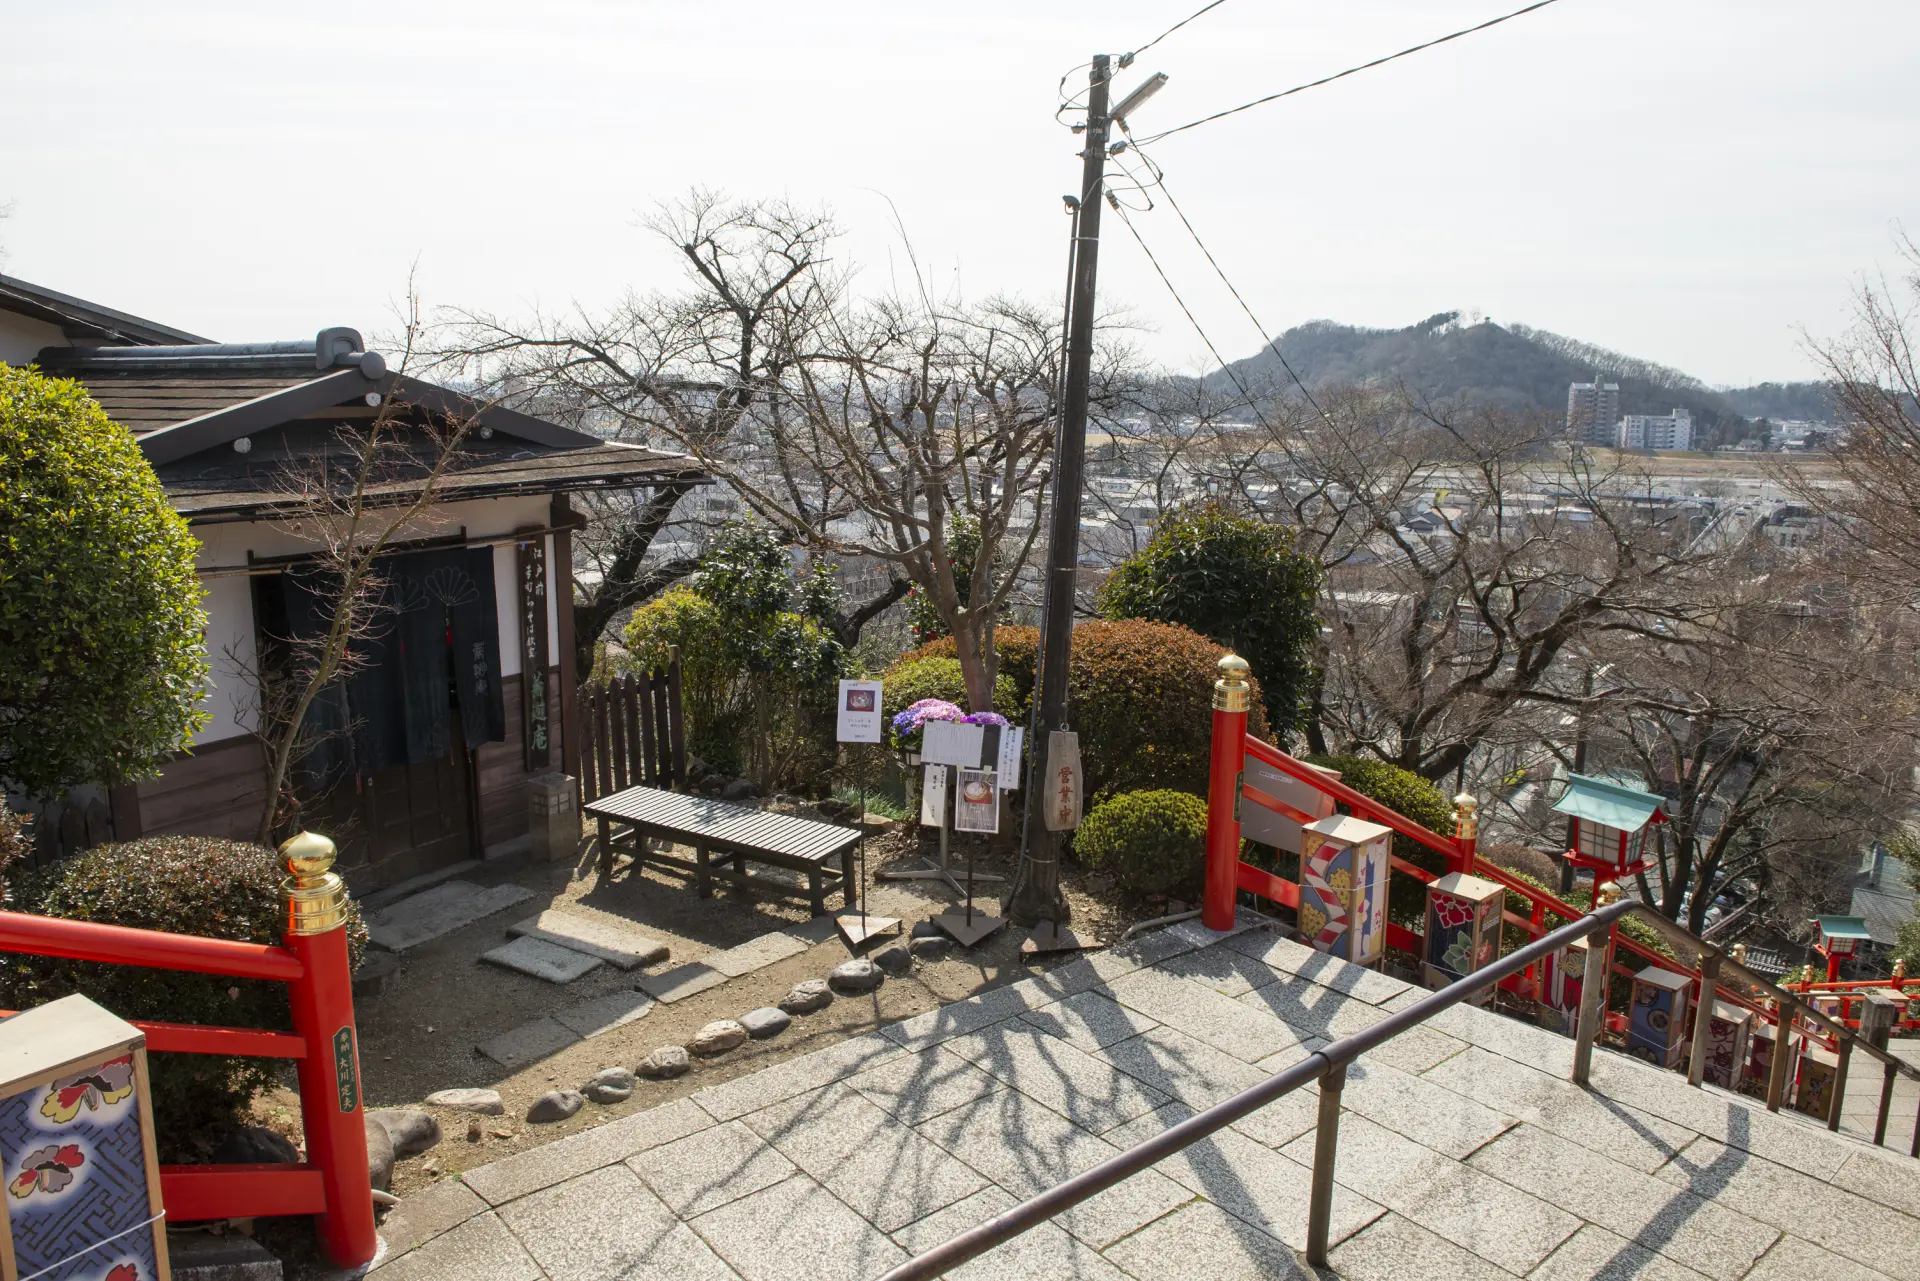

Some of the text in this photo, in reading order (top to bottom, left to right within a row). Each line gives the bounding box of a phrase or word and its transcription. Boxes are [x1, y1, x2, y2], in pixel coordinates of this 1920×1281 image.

[533, 547, 544, 596] 江戸前
[1058, 766, 1074, 824] 営業中
